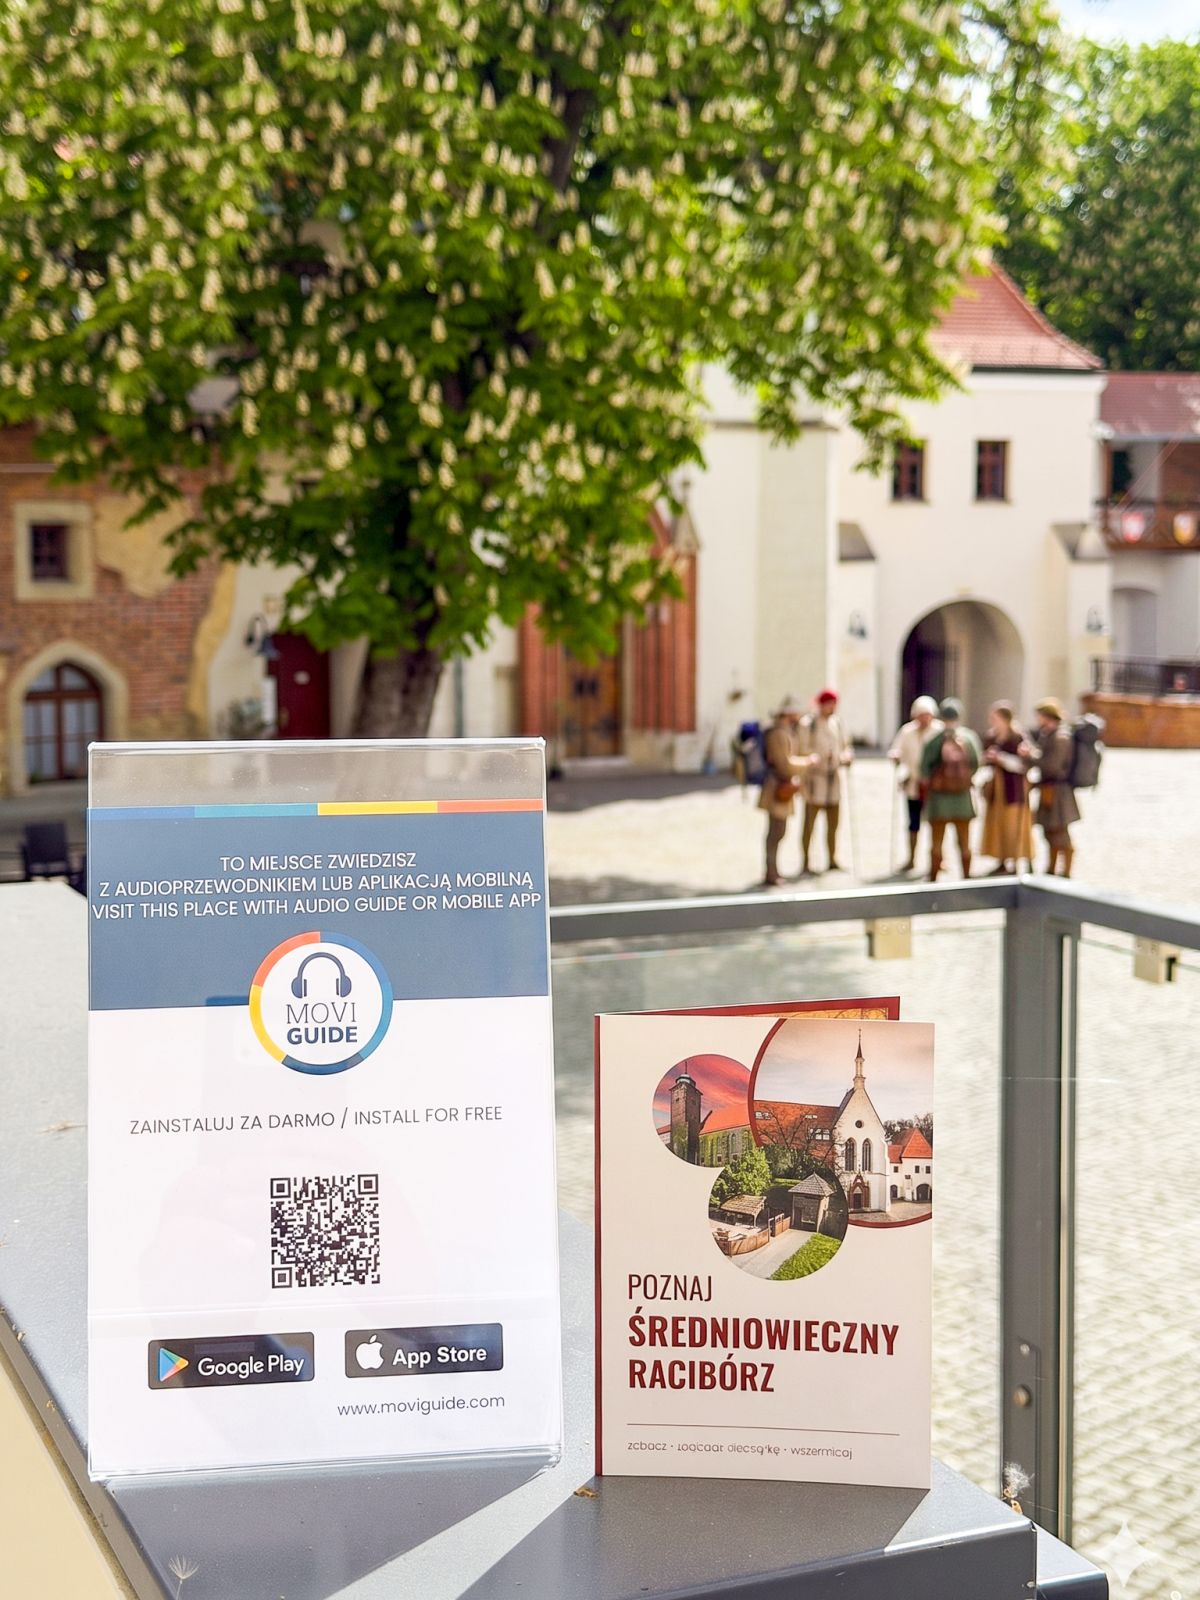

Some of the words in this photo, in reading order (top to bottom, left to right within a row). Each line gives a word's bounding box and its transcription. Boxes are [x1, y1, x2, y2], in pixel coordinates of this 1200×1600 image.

[219, 856, 245, 872] TO
[250, 854, 323, 871] MIEJSCE
[327, 852, 417, 869] ZWIEDZISZ
[99, 882, 110, 897] Z
[114, 877, 317, 897] AUDIOPRZEWODNIKIEM
[322, 875, 353, 891] LUB
[357, 873, 452, 892] APLIKACJĄ
[456, 871, 534, 889] MOBILNĄ
[92, 904, 135, 920] VISIT
[140, 902, 179, 918] THIS
[183, 900, 238, 917] PLACE
[243, 899, 288, 915] WITH
[293, 897, 350, 914] AUDIO
[354, 896, 407, 912] GUIDE
[412, 895, 437, 911] OR
[442, 894, 504, 910] MOBILE
[508, 892, 542, 909] APP
[286, 1002, 357, 1025] MOVI
[286, 1025, 358, 1046] GUIDE
[130, 1116, 235, 1135] ZAINSTALUJ
[240, 1115, 263, 1130] ZA
[268, 1112, 335, 1129] DARMO
[340, 1107, 348, 1130] /
[354, 1109, 421, 1126] INSTALL
[425, 1108, 459, 1123] FOR
[465, 1106, 503, 1121] FREE
[628, 1274, 712, 1302] POZNAJ
[628, 1306, 900, 1356] ŚREDNIOWIECZNY
[197, 1355, 265, 1379] Google
[267, 1354, 305, 1376] Play
[392, 1348, 432, 1369] App
[437, 1345, 487, 1363] Store
[628, 1353, 775, 1393] RACIBÓRZ
[337, 1395, 505, 1416] www.moviguide.com
